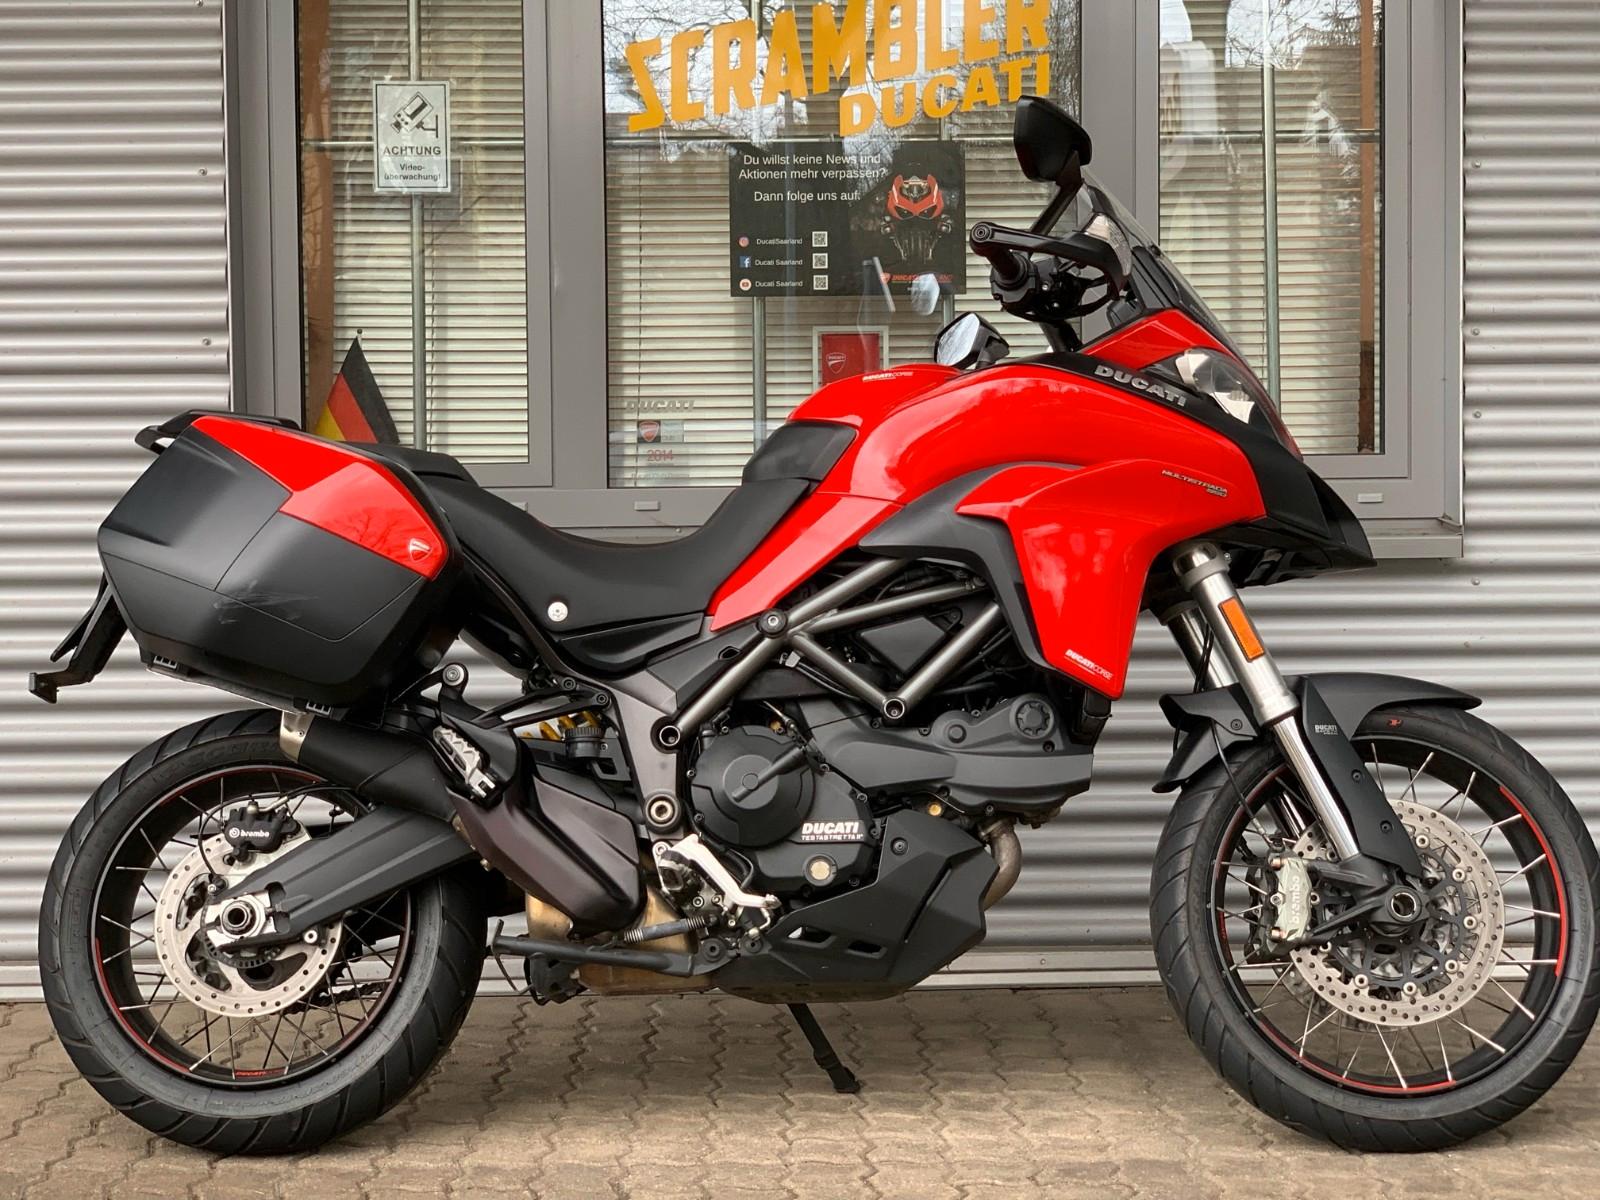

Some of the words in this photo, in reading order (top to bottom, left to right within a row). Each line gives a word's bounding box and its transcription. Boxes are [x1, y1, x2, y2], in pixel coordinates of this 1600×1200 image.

[625, 0, 1050, 133] SCRAMBLER
[839, 54, 1050, 137] DUCATI
[383, 146, 441, 156] ACHTUNG
[743, 154, 760, 165] Du
[763, 154, 790, 165] willst
[793, 154, 823, 165] keine
[826, 154, 857, 165] News
[860, 153, 881, 164] und
[400, 163, 425, 171] Video-
[384, 173, 441, 182] überwachung!
[738, 169, 787, 180] Aktionen
[790, 168, 819, 179] mehr
[822, 167, 887, 181] verpassen?
[754, 191, 783, 201] Dann
[787, 190, 814, 203] folge
[817, 192, 838, 201] uns
[1094, 365, 1187, 406] DUCATI
[646, 449, 674, 462] 2014
[241, 829, 270, 837] brembo
[802, 822, 859, 834] DUCATI
[1288, 875, 1301, 925] brembo
